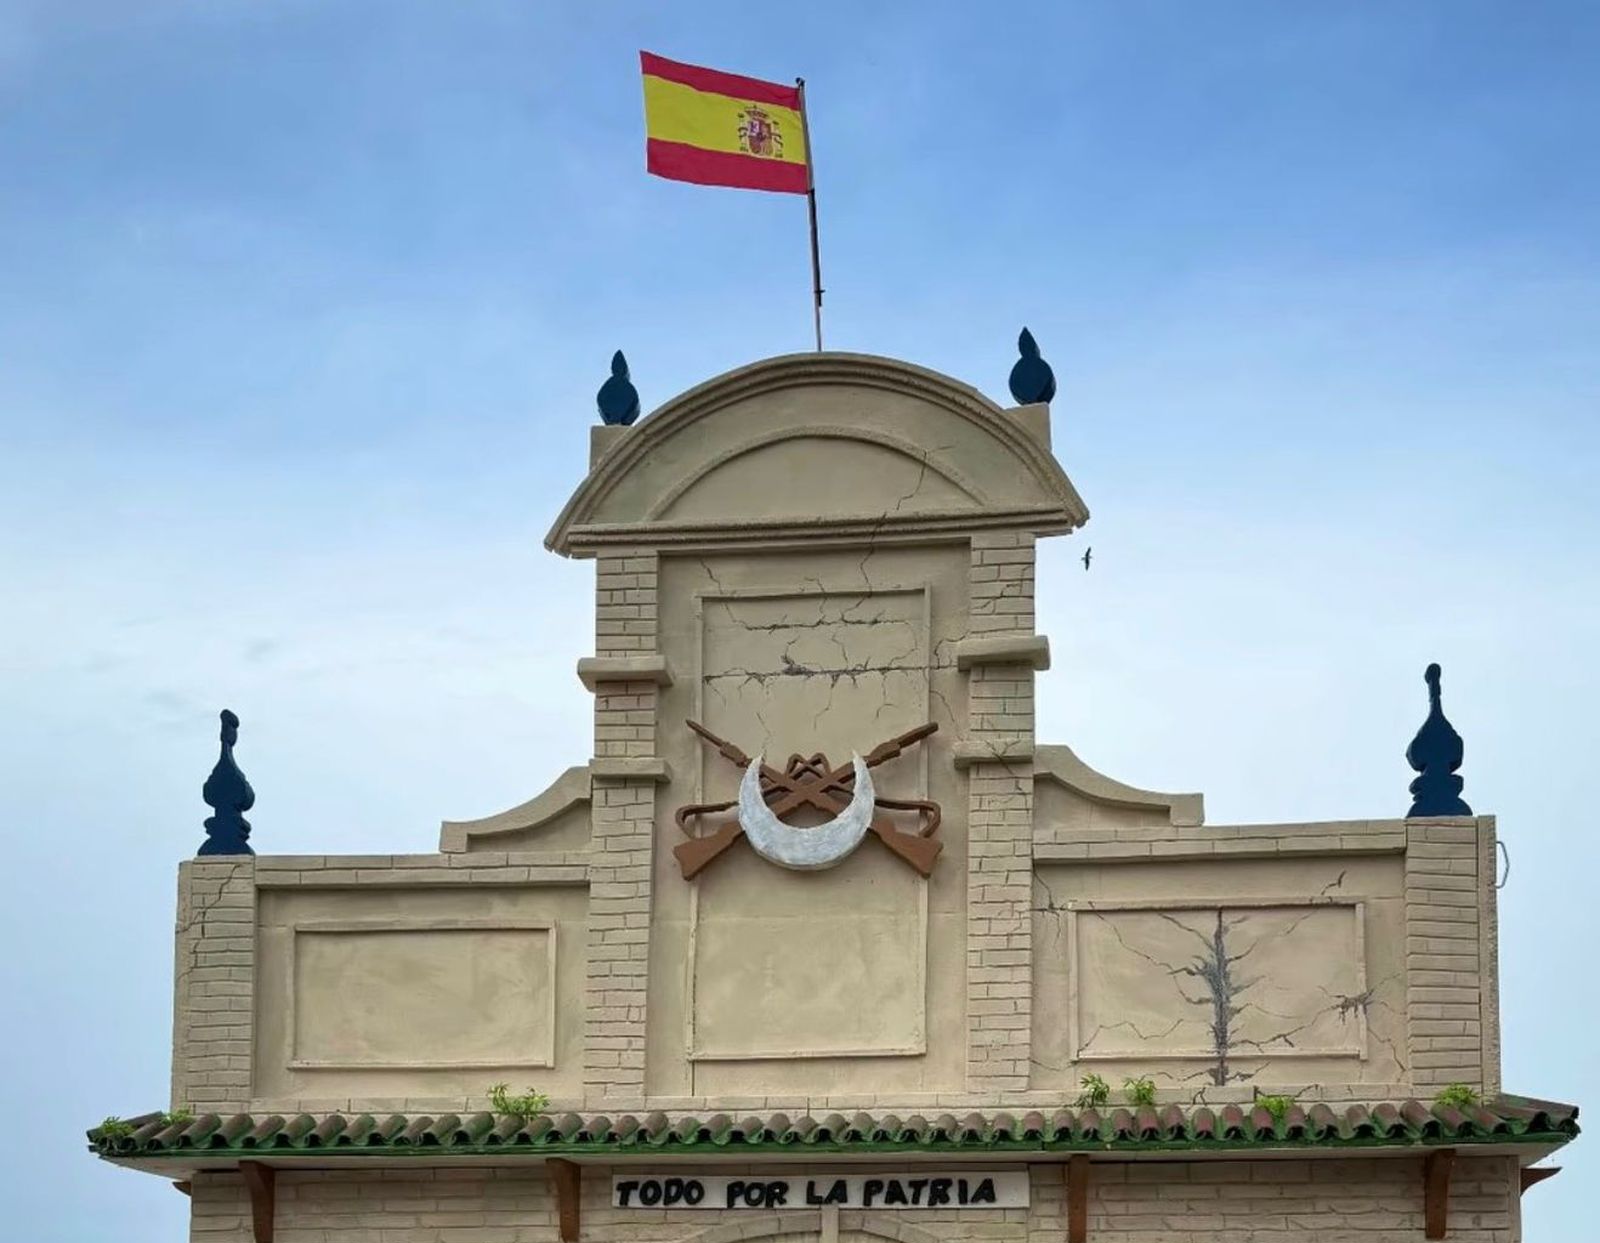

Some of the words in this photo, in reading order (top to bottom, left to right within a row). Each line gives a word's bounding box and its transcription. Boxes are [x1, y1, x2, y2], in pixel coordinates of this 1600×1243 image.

[616, 1178, 705, 1206] TODO
[727, 1181, 789, 1209] POR
[806, 1179, 848, 1205] LA
[863, 1178, 997, 1206] PATRIA
